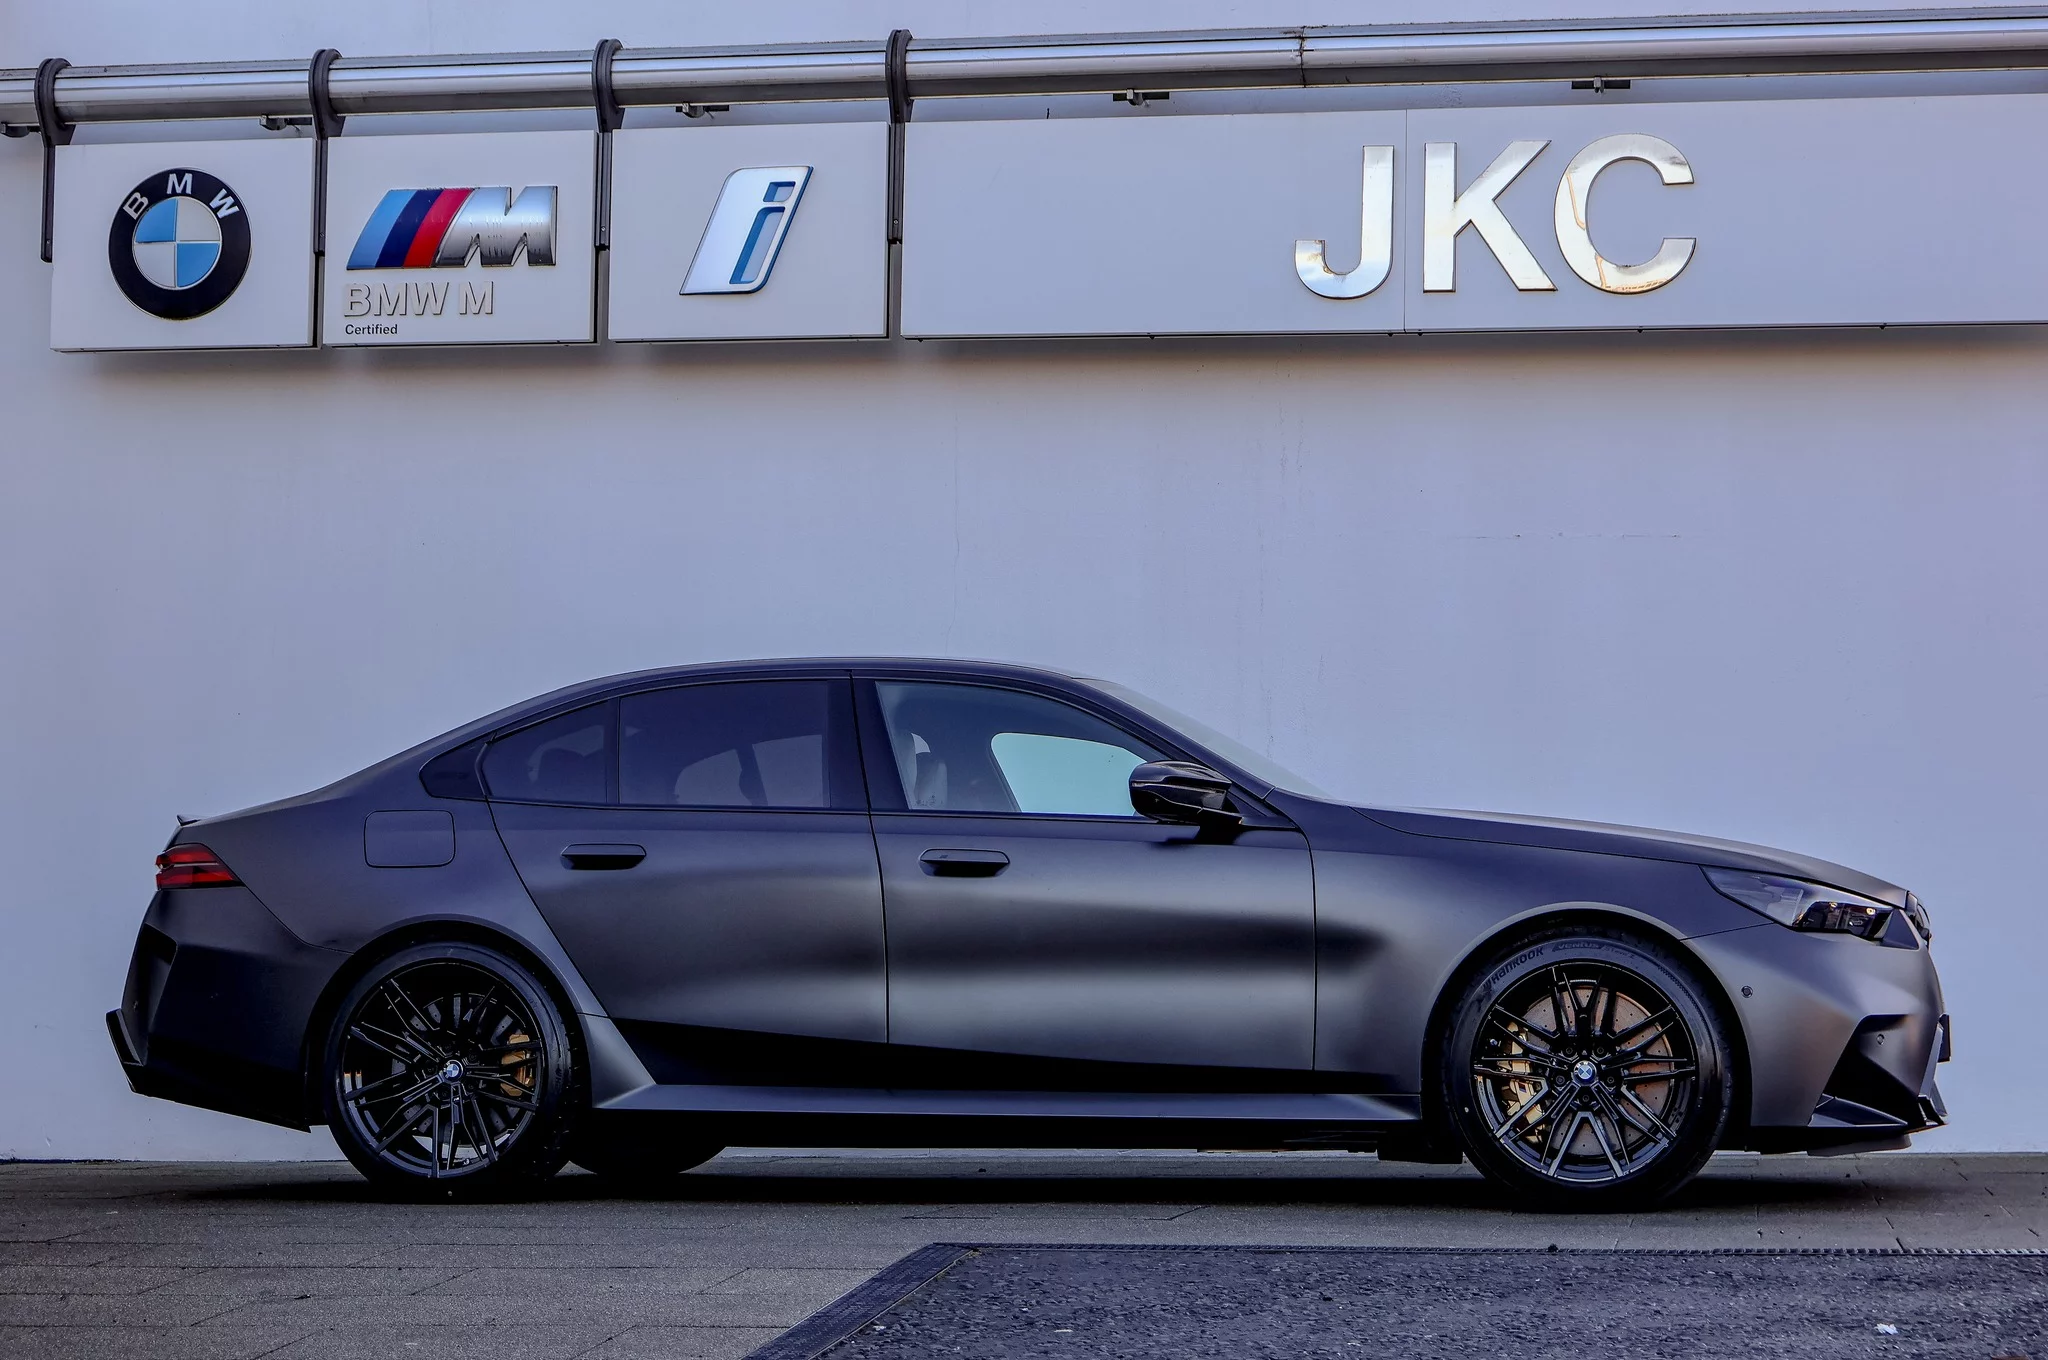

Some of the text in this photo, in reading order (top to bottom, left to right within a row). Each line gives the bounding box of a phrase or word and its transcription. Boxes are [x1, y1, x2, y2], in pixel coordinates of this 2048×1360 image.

[122, 171, 242, 221] BMW
[1294, 132, 1697, 301] JKC
[344, 280, 495, 317] BMW M
[345, 322, 399, 336] Certified
